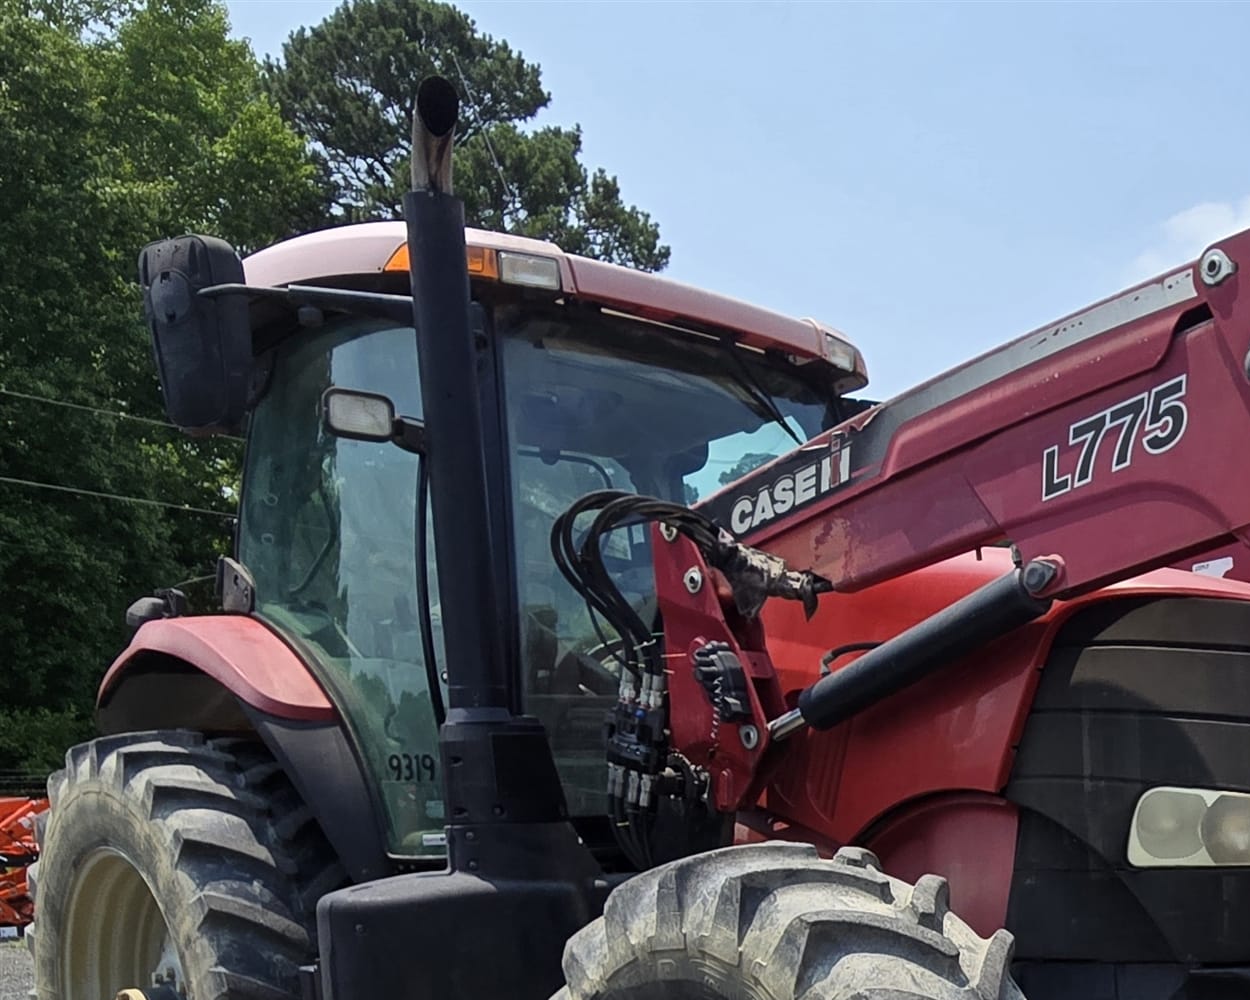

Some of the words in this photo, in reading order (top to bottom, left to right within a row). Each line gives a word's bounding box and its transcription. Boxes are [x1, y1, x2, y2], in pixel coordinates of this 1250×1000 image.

[1042, 373, 1188, 502] L775
[731, 464, 817, 534] CASE
[388, 753, 435, 782] 9319
